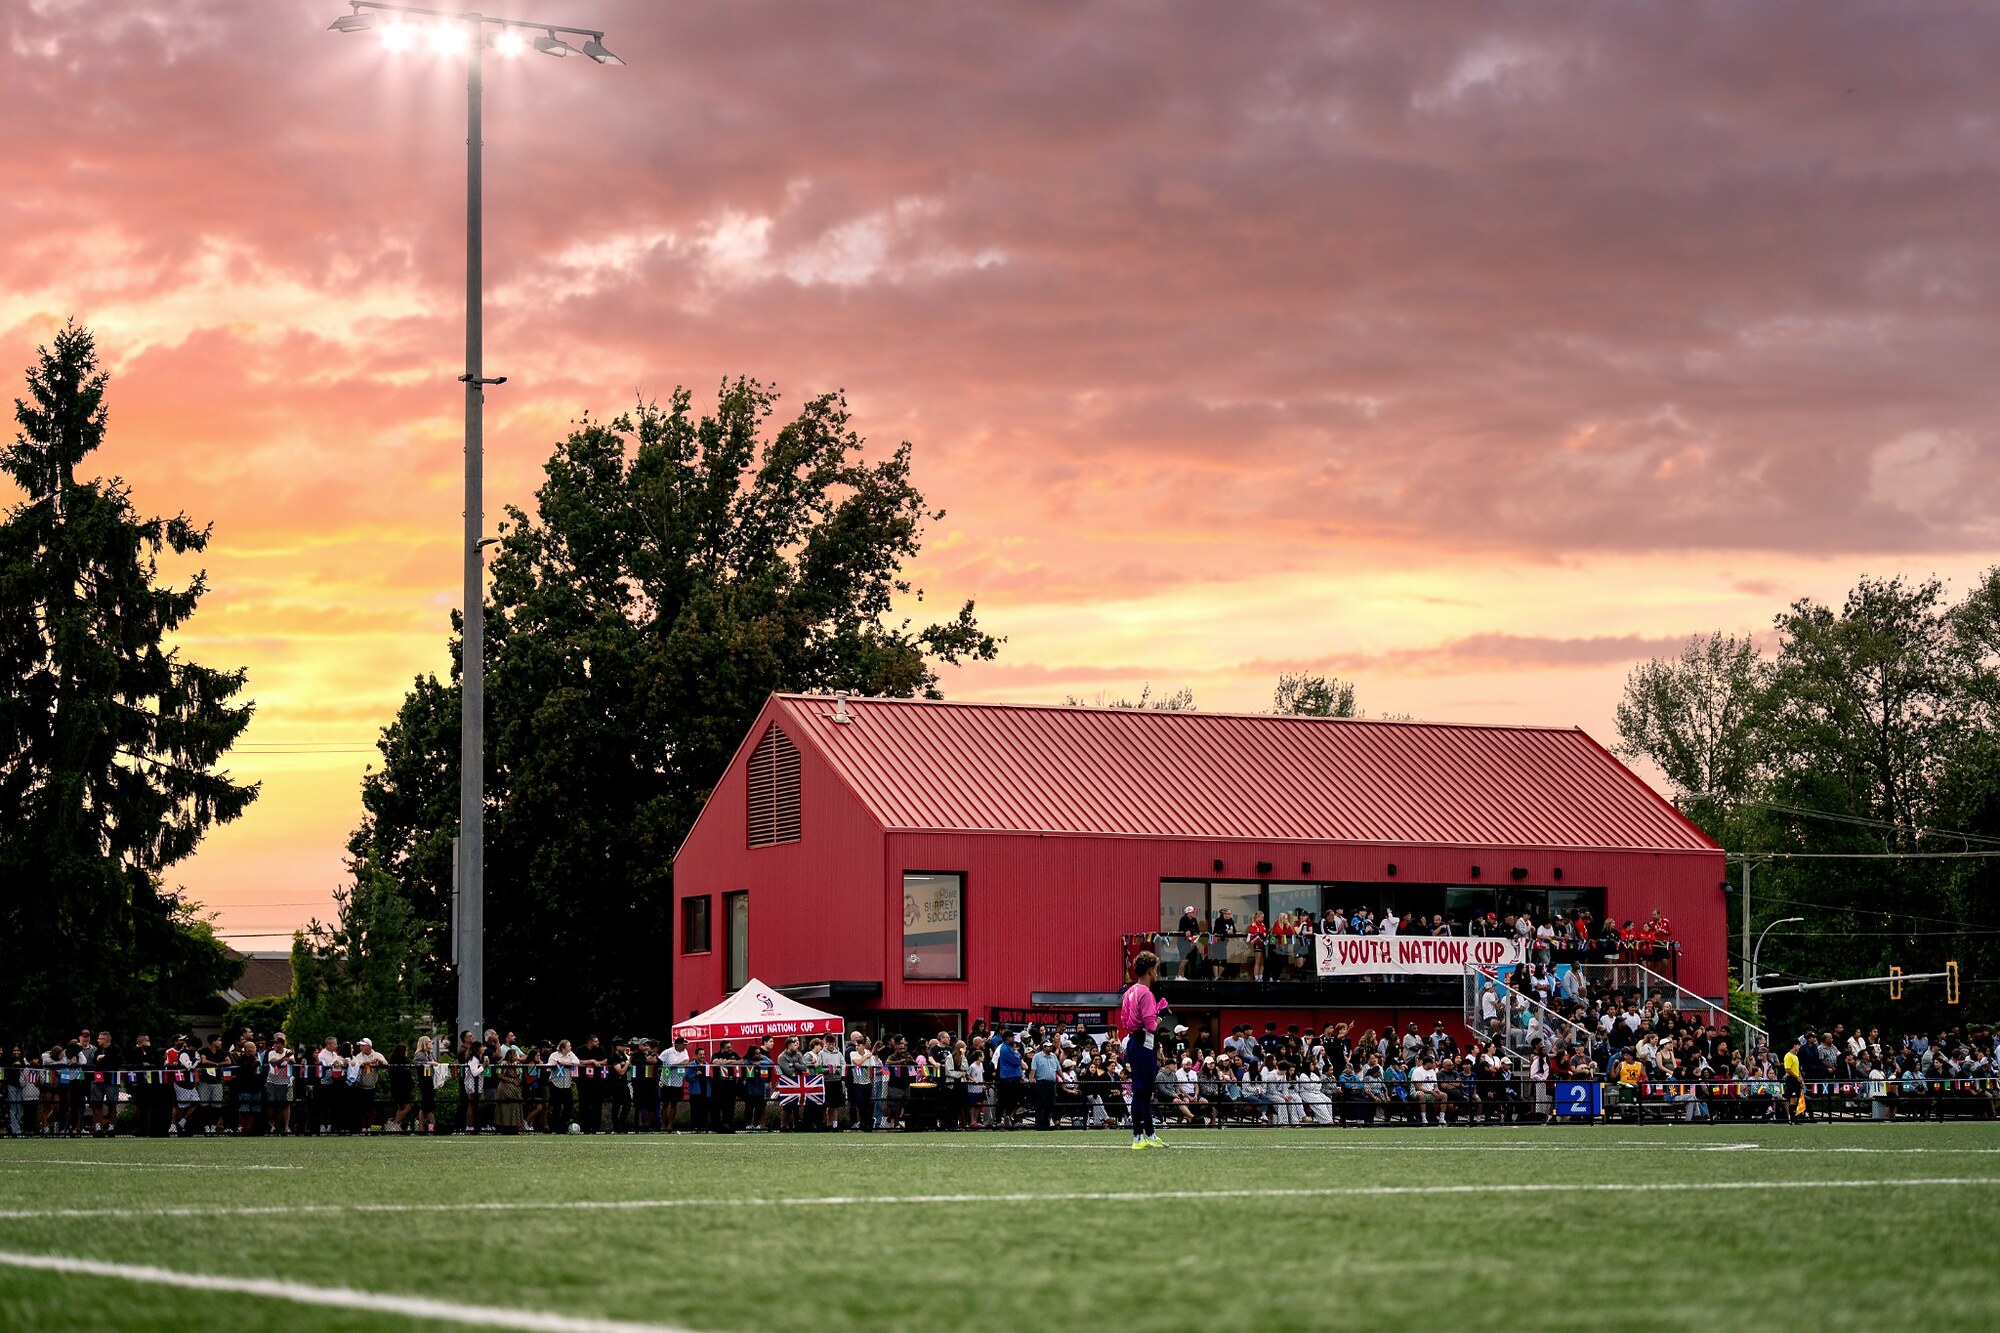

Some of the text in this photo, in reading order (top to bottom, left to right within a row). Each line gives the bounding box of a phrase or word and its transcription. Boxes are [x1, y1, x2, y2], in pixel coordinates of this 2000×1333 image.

[924, 899, 954, 912] SURREY
[1338, 940, 1505, 965] YOUTH NATIONS CUP
[999, 1011, 1022, 1022] YOUTH
[740, 1022, 815, 1035] YOUTH NATIONS CUP
[1570, 1085, 1587, 1112] 2
